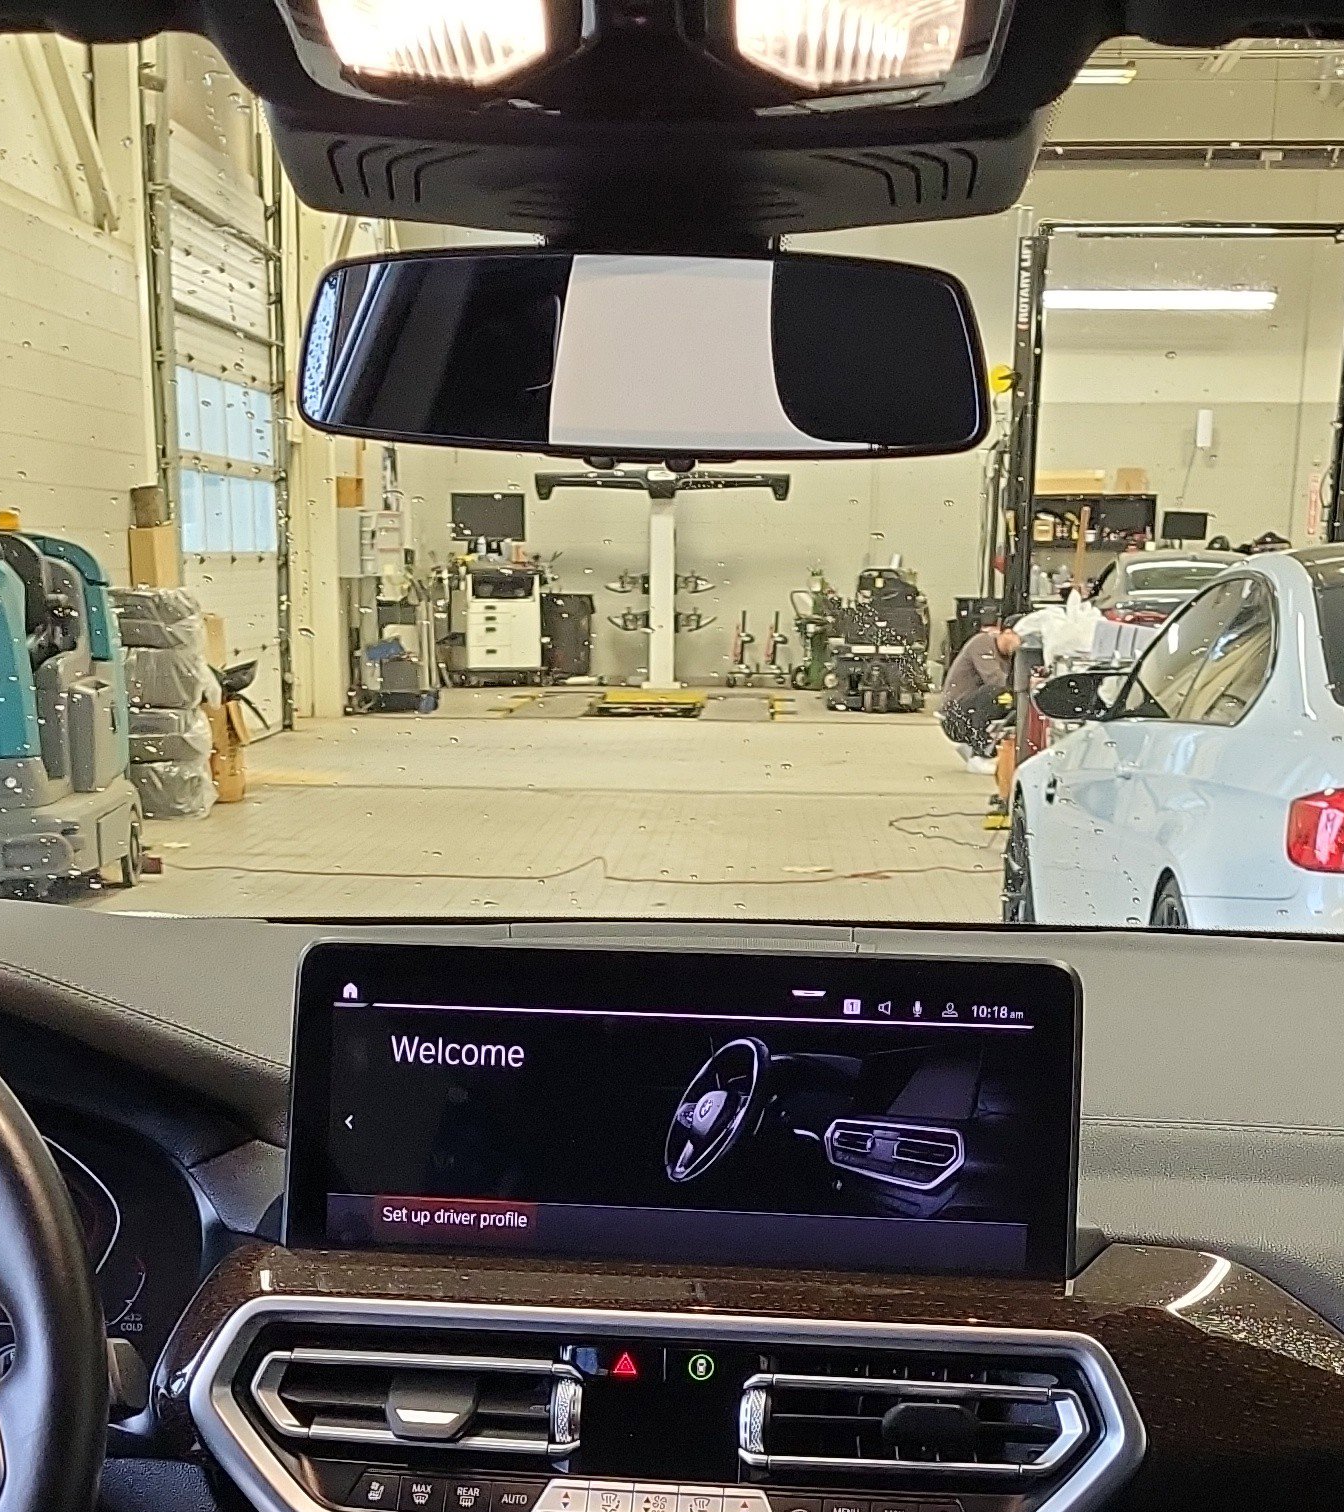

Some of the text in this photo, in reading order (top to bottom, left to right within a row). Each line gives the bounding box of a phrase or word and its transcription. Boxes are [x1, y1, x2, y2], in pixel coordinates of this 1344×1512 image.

[1018, 240, 1033, 322] ROTARY LIFT
[971, 1005, 1024, 1020] 10:18 am
[391, 1035, 525, 1067] Welcome
[382, 1207, 527, 1228] Set up driver profile
[120, 1322, 143, 1332] COLD
[411, 1483, 432, 1494] MAX
[456, 1486, 480, 1498] REAR
[501, 1493, 528, 1505] AUTO
